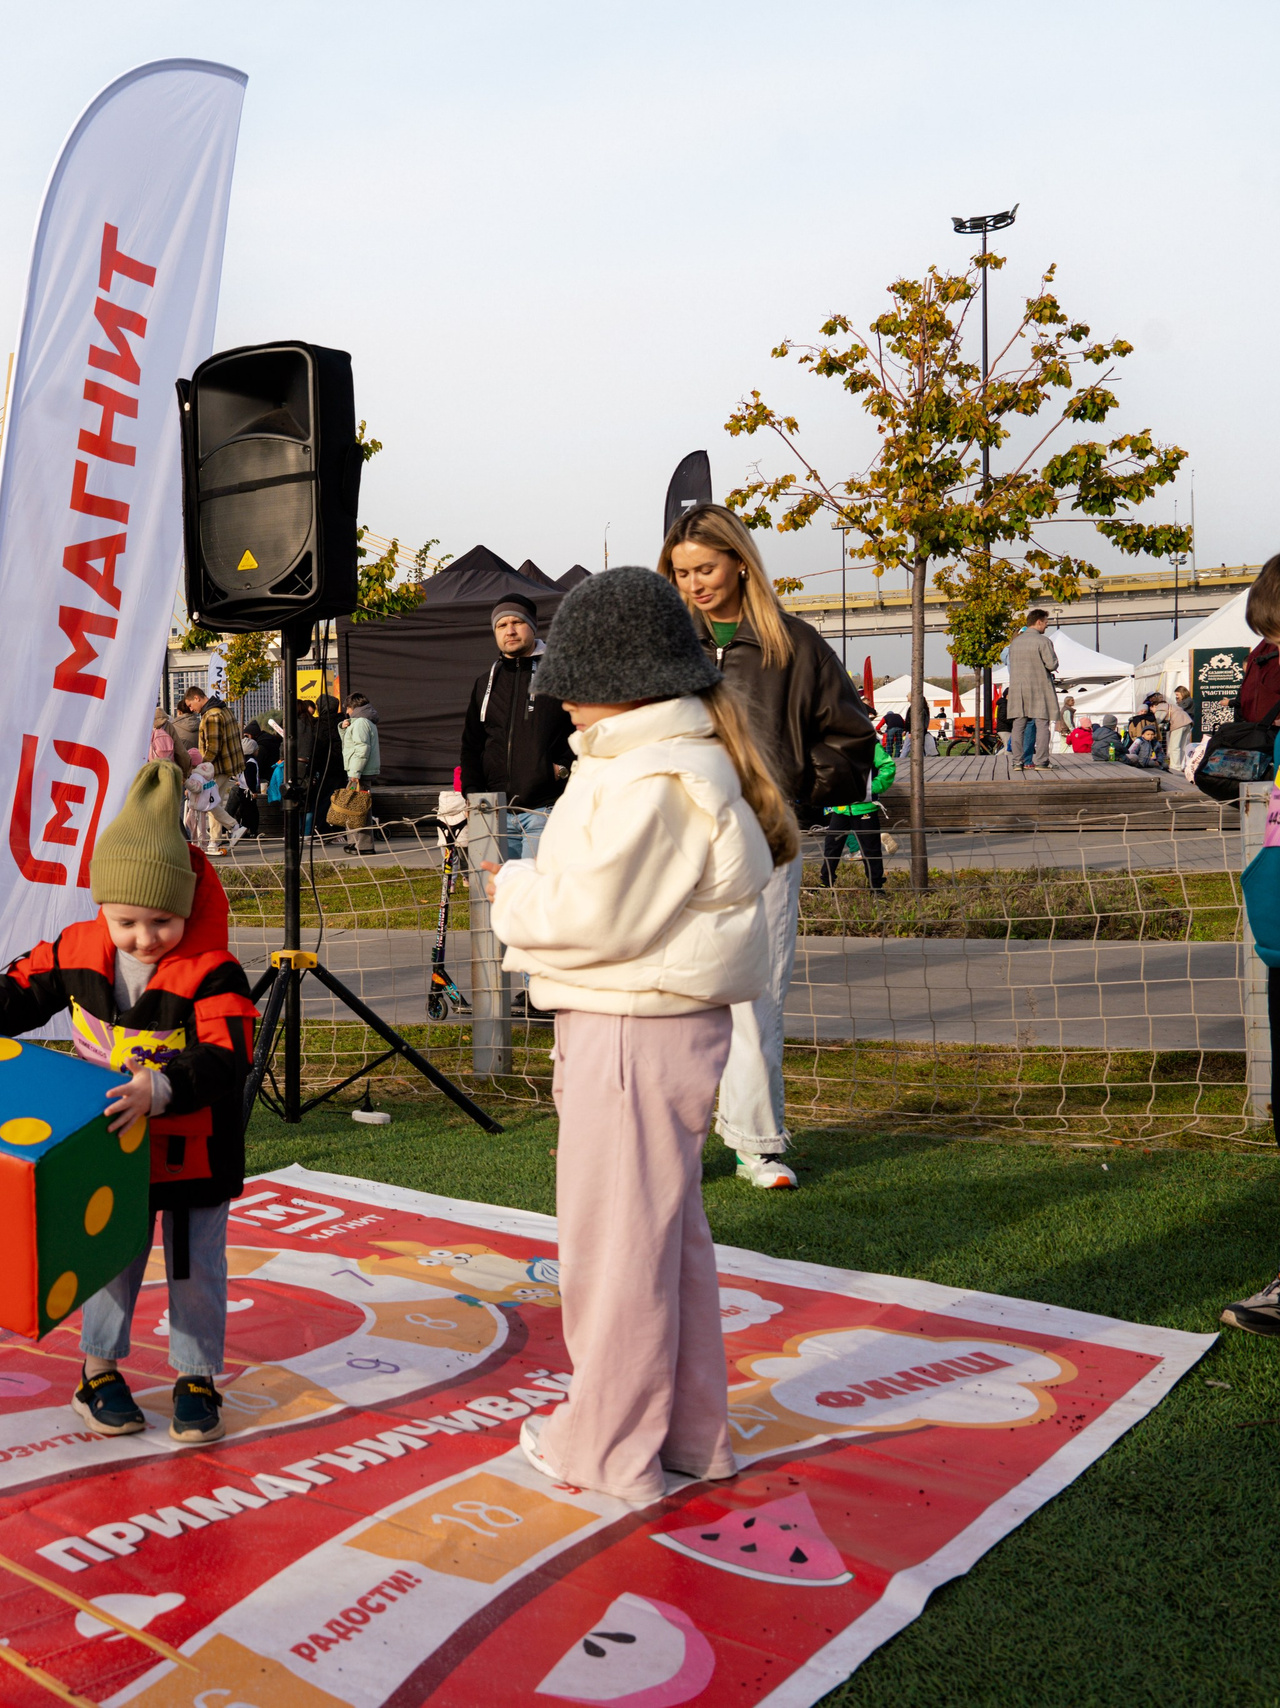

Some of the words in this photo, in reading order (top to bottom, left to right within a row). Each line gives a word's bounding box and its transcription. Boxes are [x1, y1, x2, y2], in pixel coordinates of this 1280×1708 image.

[53, 222, 157, 700] МАГНИТ
[302, 1214, 386, 1242] МАГНИТ
[331, 1269, 374, 1287] 7
[404, 1312, 458, 1331] 8
[346, 1357, 400, 1375] 9
[88, 1373, 117, 1390] Tombi
[187, 1383, 213, 1397] Tombi
[815, 1351, 1015, 1410] ФИНИШ
[431, 1500, 521, 1538] 18
[290, 1569, 424, 1665] РАДОСТИ!
